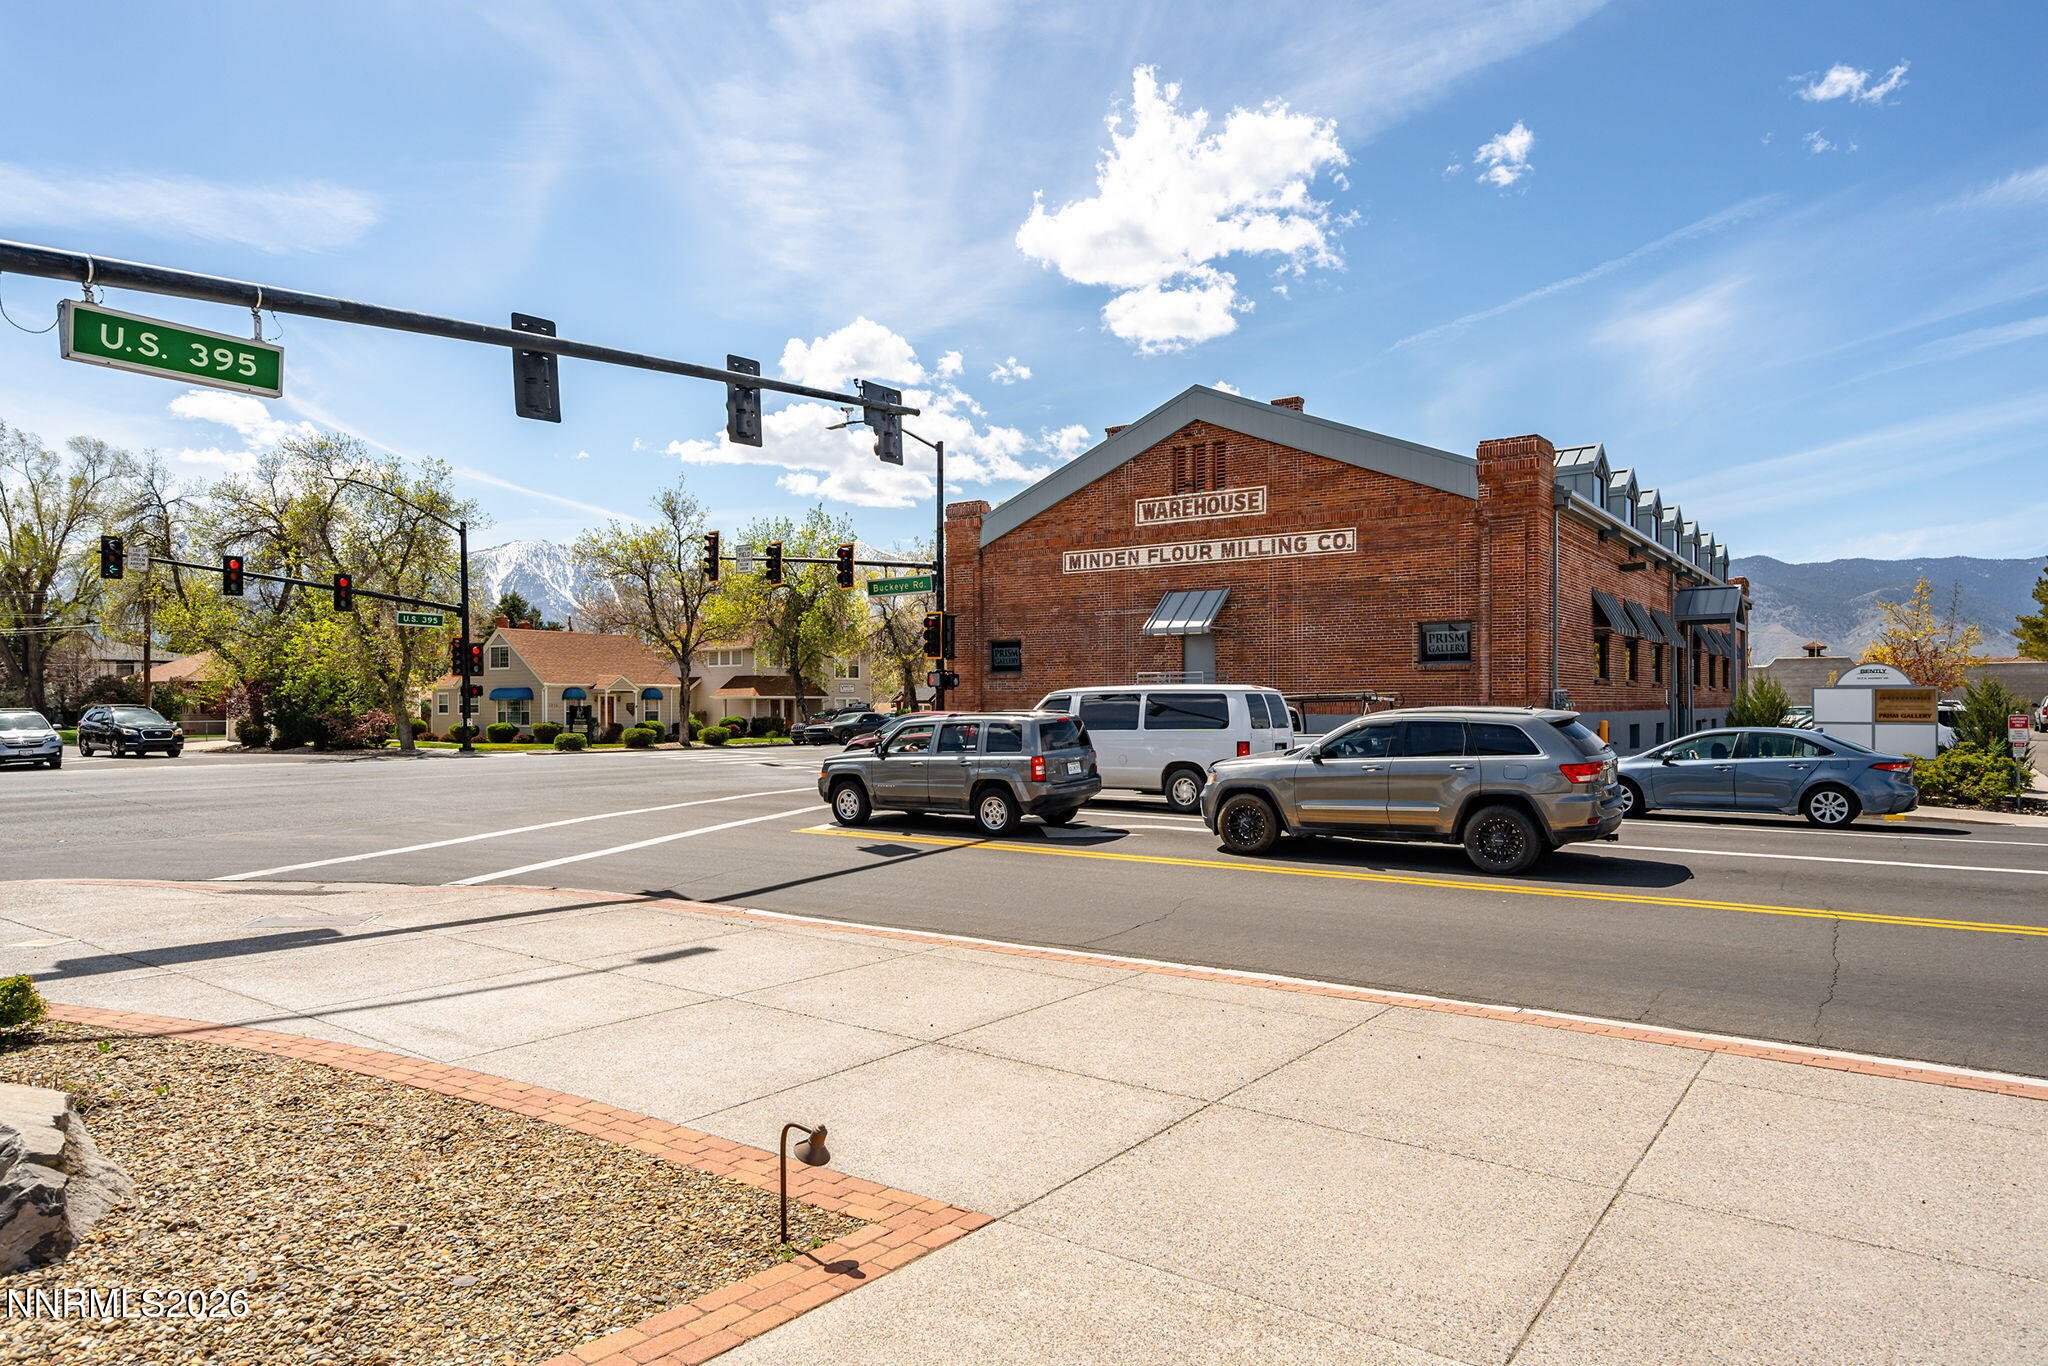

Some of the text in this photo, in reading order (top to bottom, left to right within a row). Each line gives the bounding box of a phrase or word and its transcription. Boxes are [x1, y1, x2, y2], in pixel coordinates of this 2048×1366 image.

[101, 323, 257, 376] U.S. 395
[1141, 491, 1261, 520] WAREHOUSE
[1068, 533, 1352, 571] MINDEN FLOUR MILLING CO.
[873, 580, 927, 593] Buckeye Rd.
[403, 615, 438, 624] U.S. 395
[1428, 633, 1465, 644] PRISM
[994, 649, 1018, 657] PRISM
[1428, 643, 1466, 653] GALLERY
